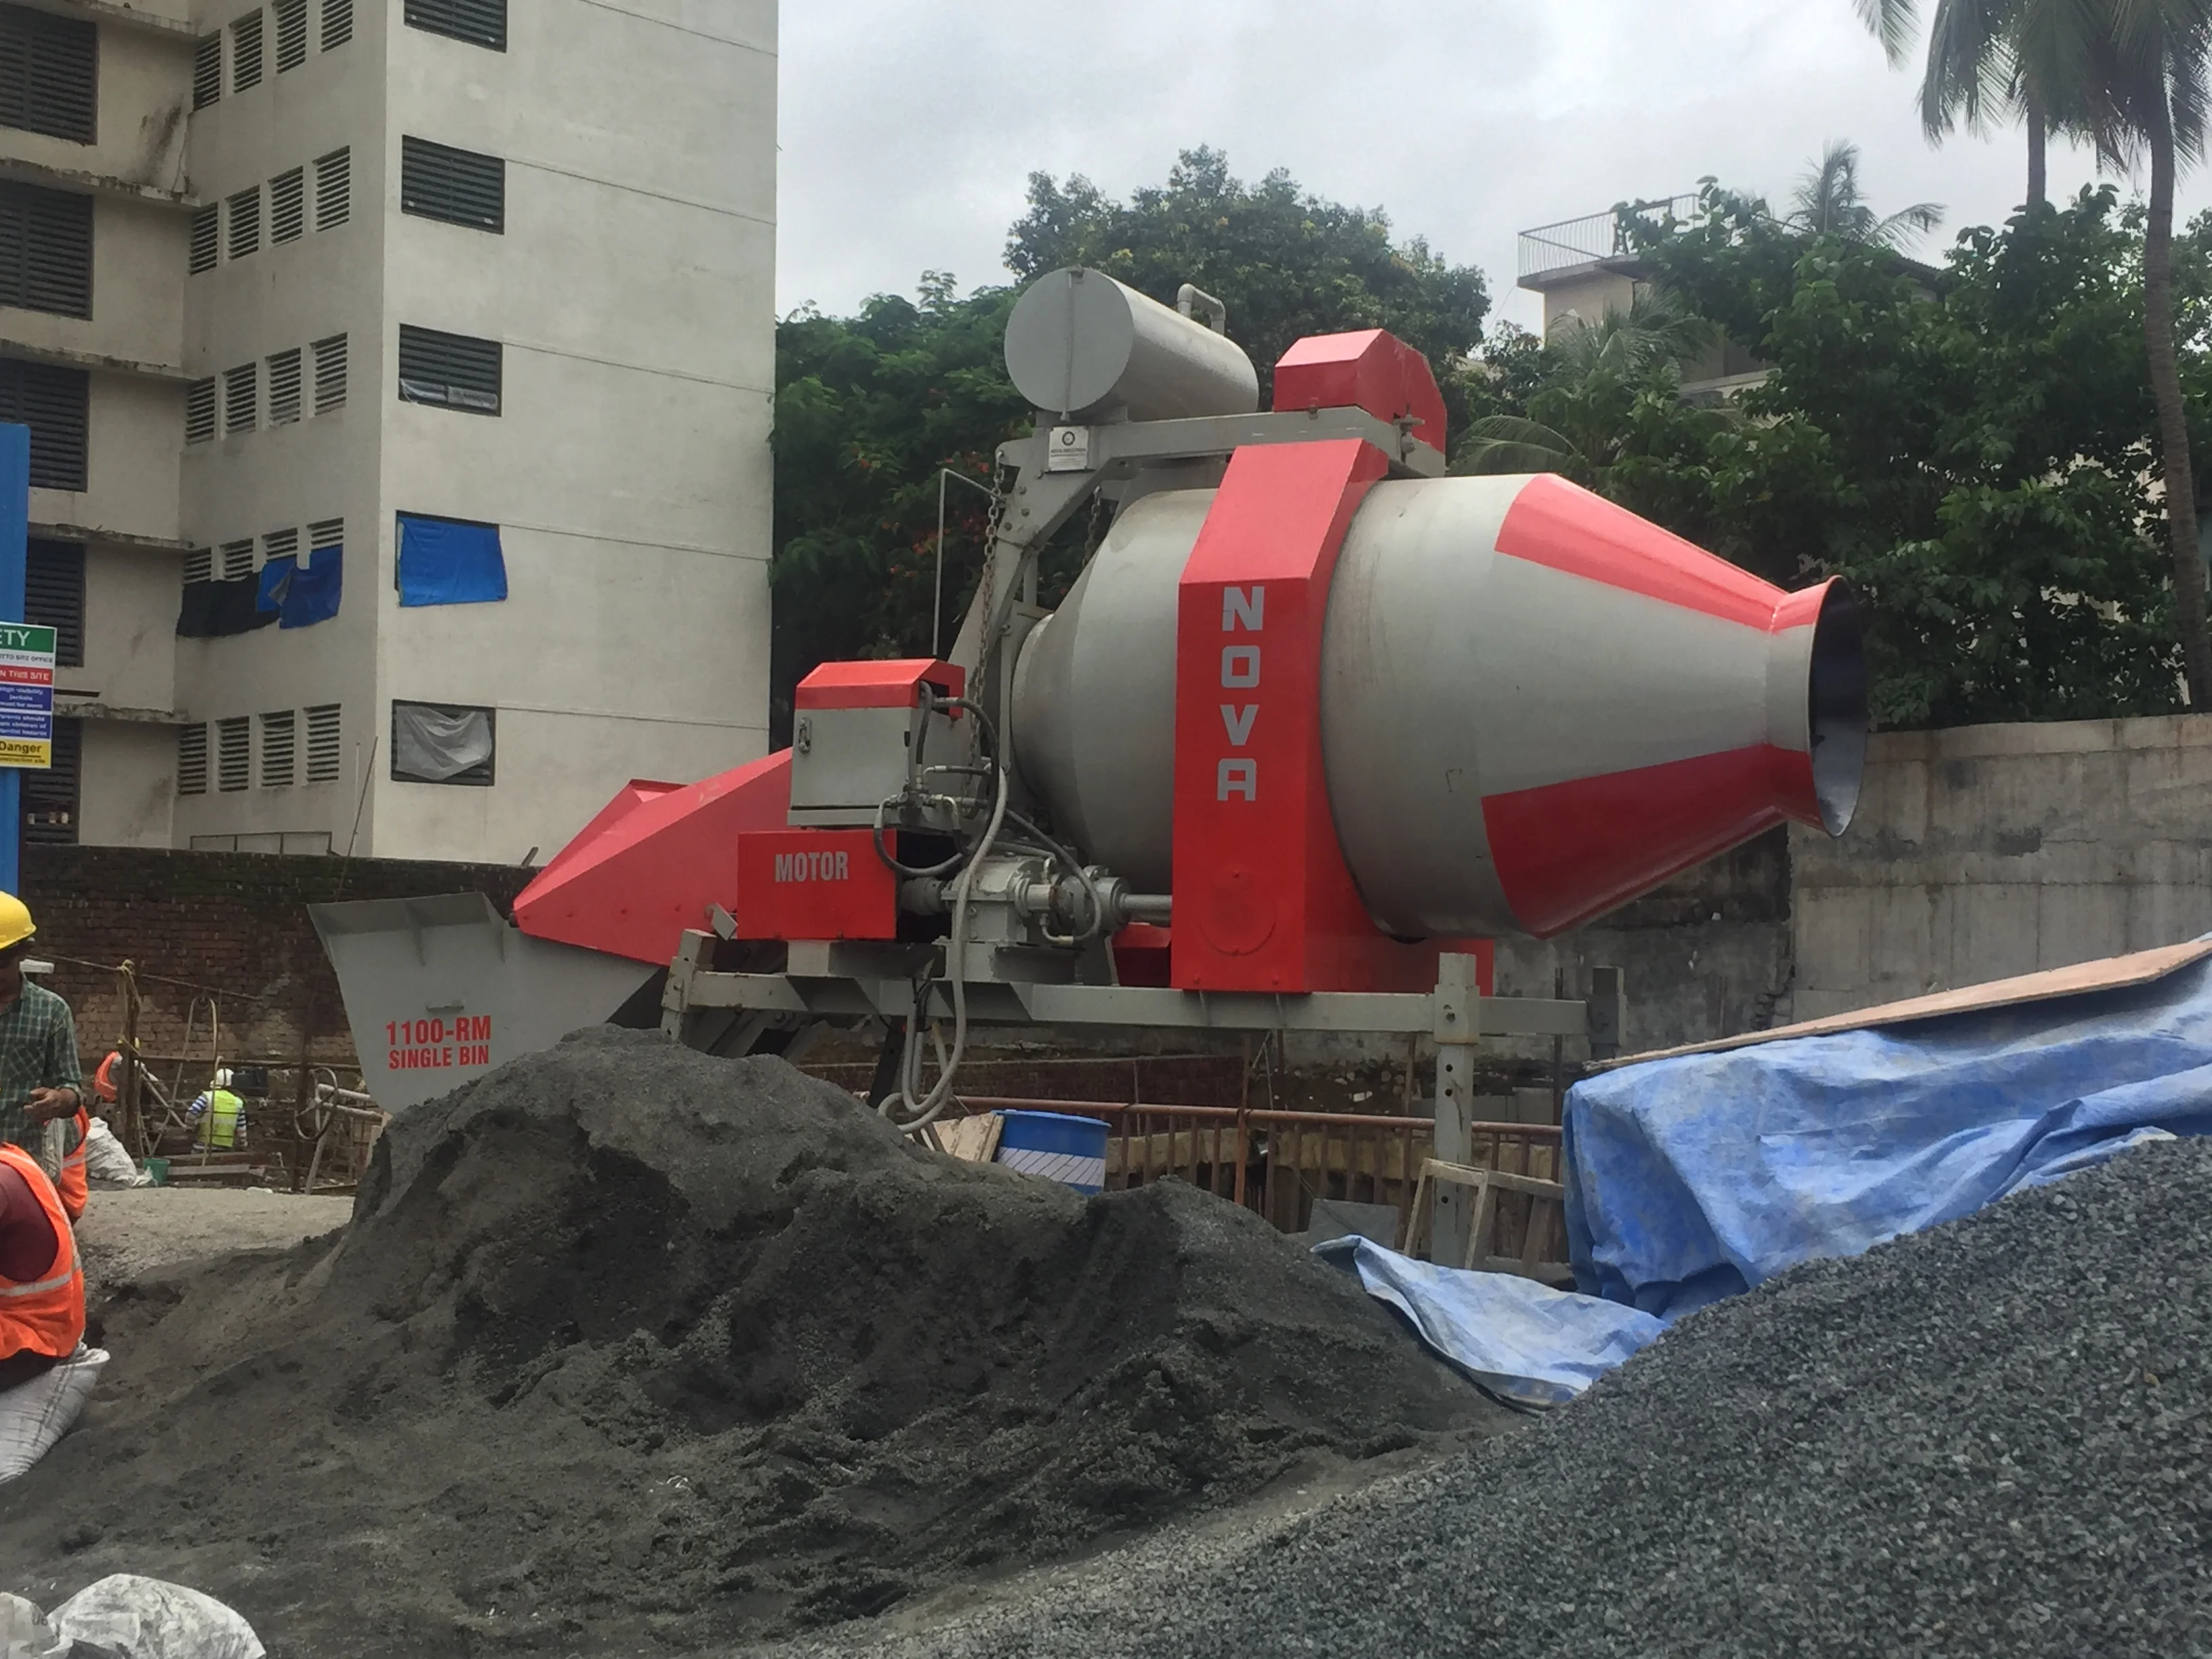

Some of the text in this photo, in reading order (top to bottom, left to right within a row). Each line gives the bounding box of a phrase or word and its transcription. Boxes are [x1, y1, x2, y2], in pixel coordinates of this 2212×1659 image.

[30, 672, 49, 680] SITE
[1217, 586, 1265, 801] NOVA
[0, 741, 42, 754] Danger
[775, 851, 848, 882] MOTOR
[386, 1015, 491, 1045] 1100-RM
[388, 1045, 489, 1069] SINGLE BIN
